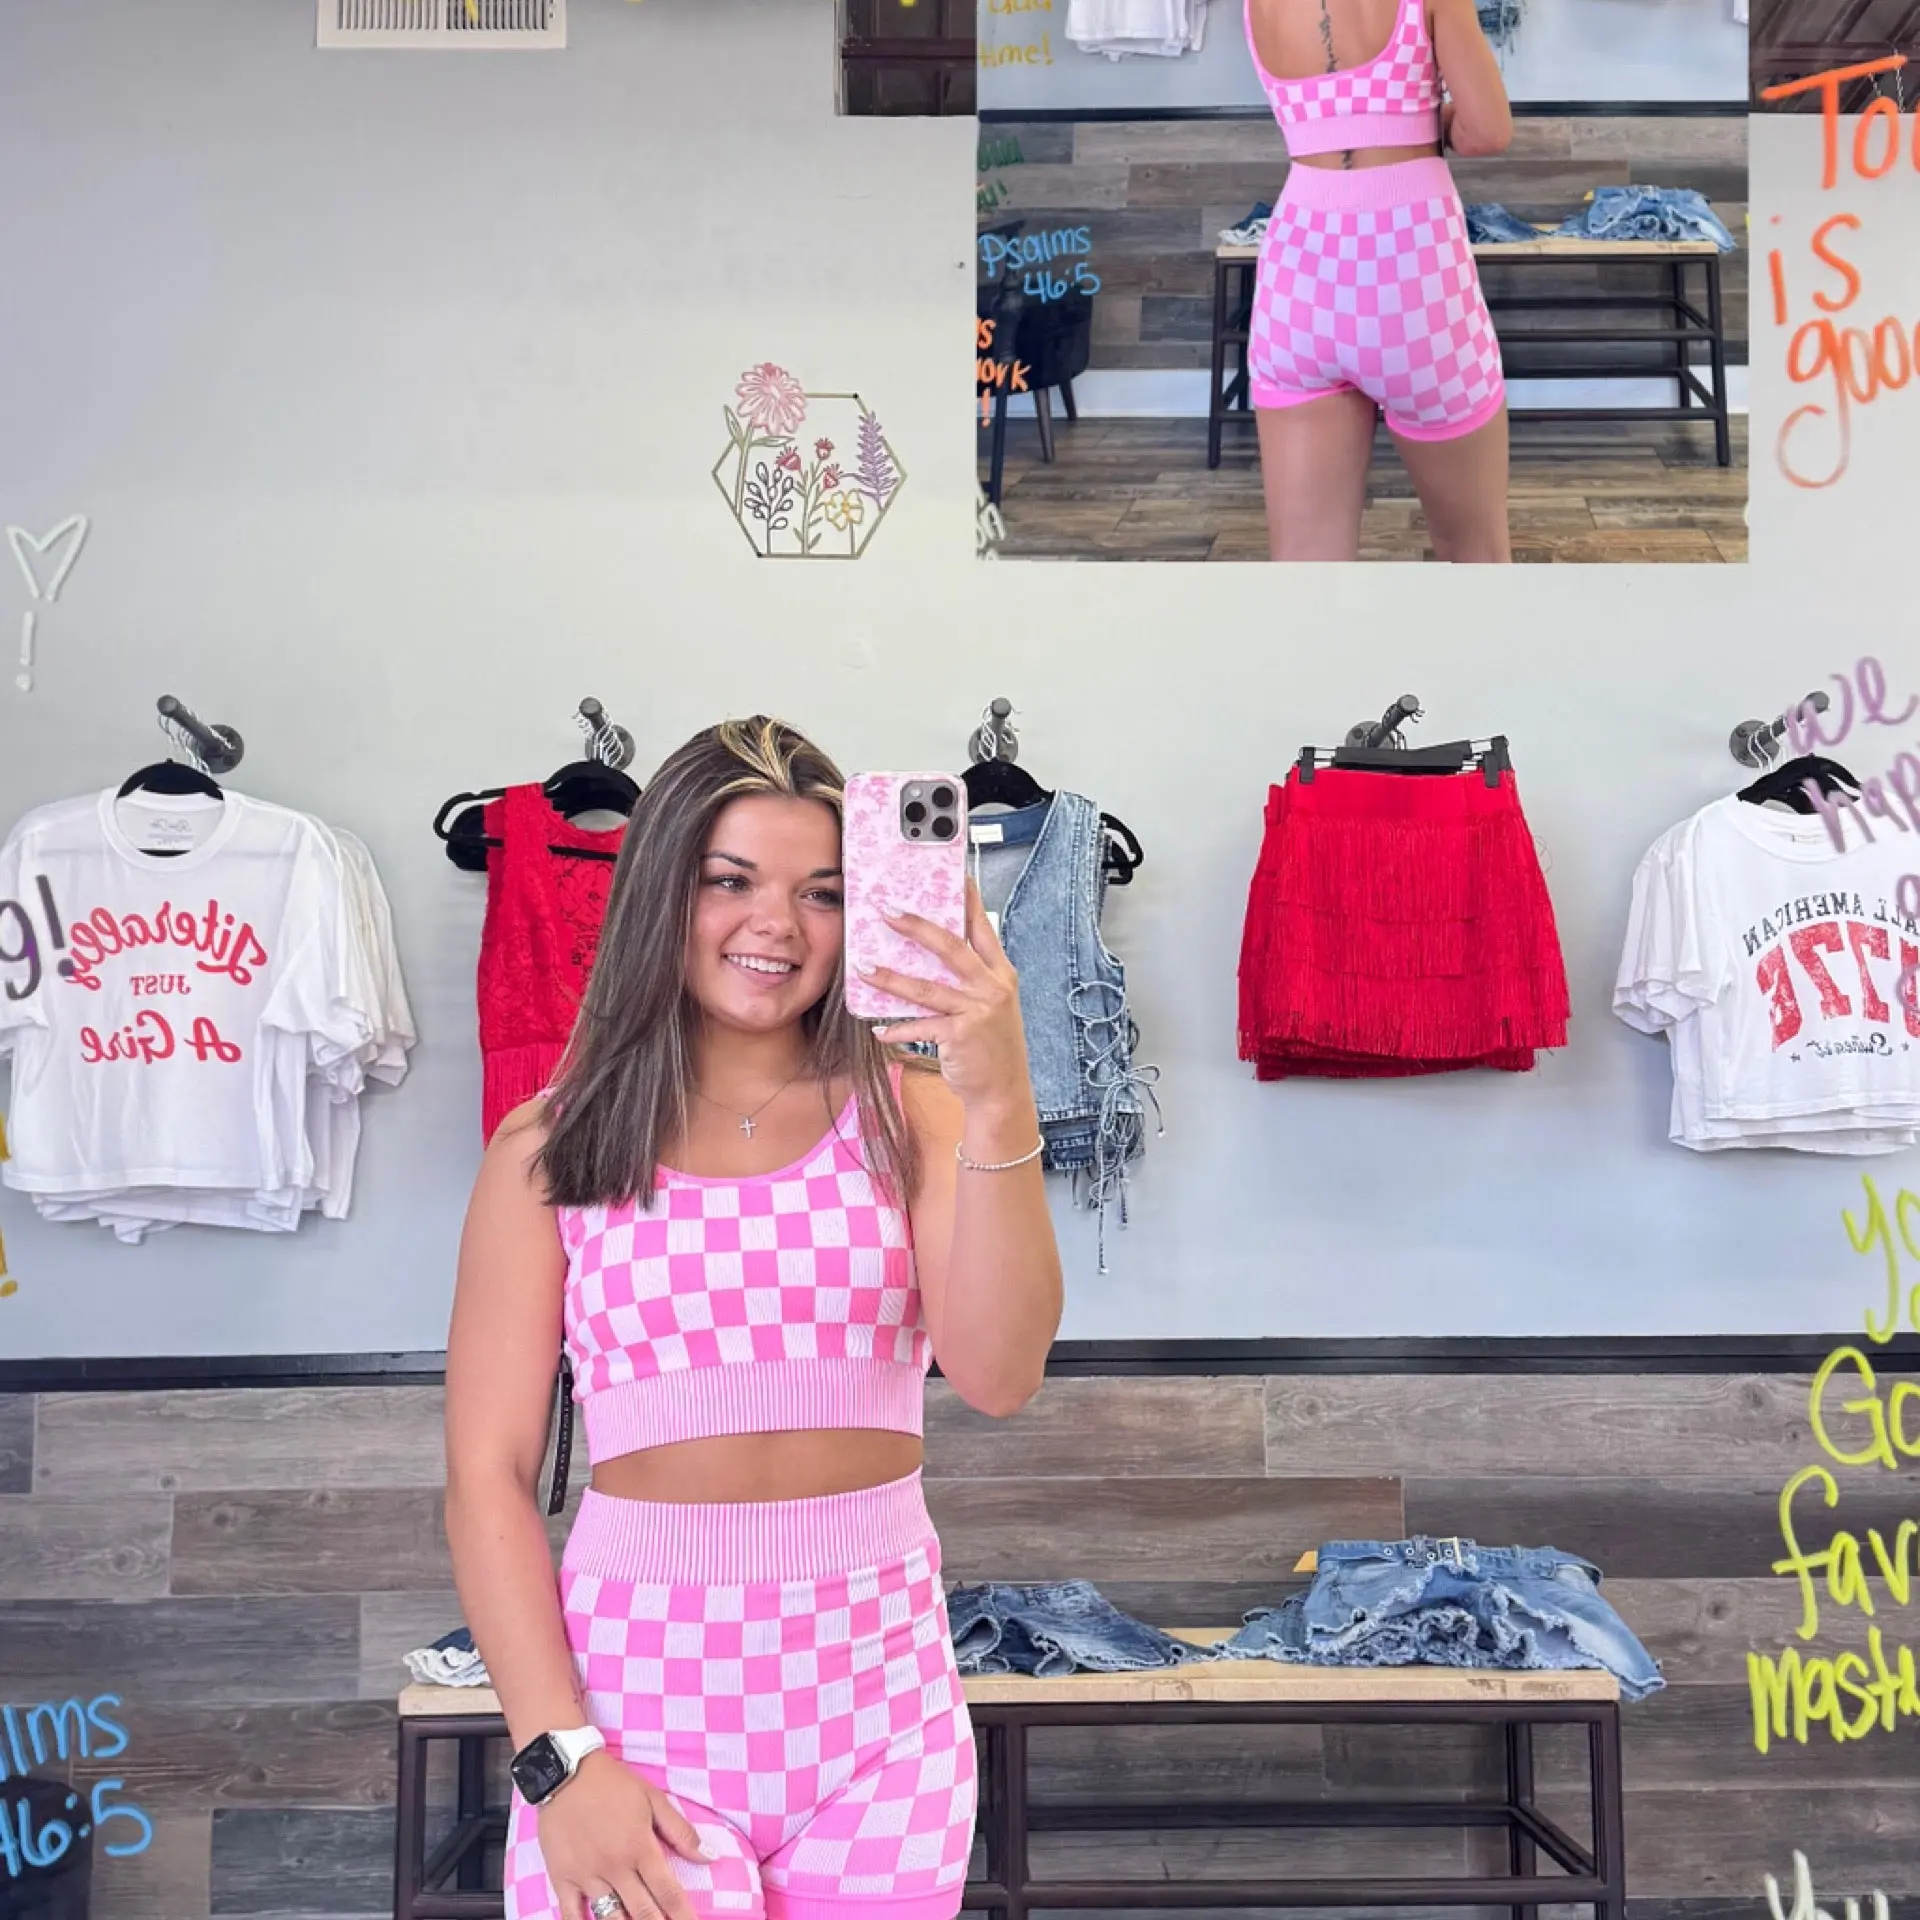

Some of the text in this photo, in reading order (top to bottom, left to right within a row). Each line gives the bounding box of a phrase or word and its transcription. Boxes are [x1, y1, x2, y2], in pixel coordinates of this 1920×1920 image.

[1761, 54, 1920, 190] To
[978, 225, 1092, 279] Psalms
[1023, 262, 1101, 304] 46:5
[1768, 212, 1862, 326] is
[1775, 316, 1920, 489] goo
[1802, 741, 1920, 854] hap
[1772, 1464, 1920, 1640] fav
[0, 1692, 129, 1782] lms
